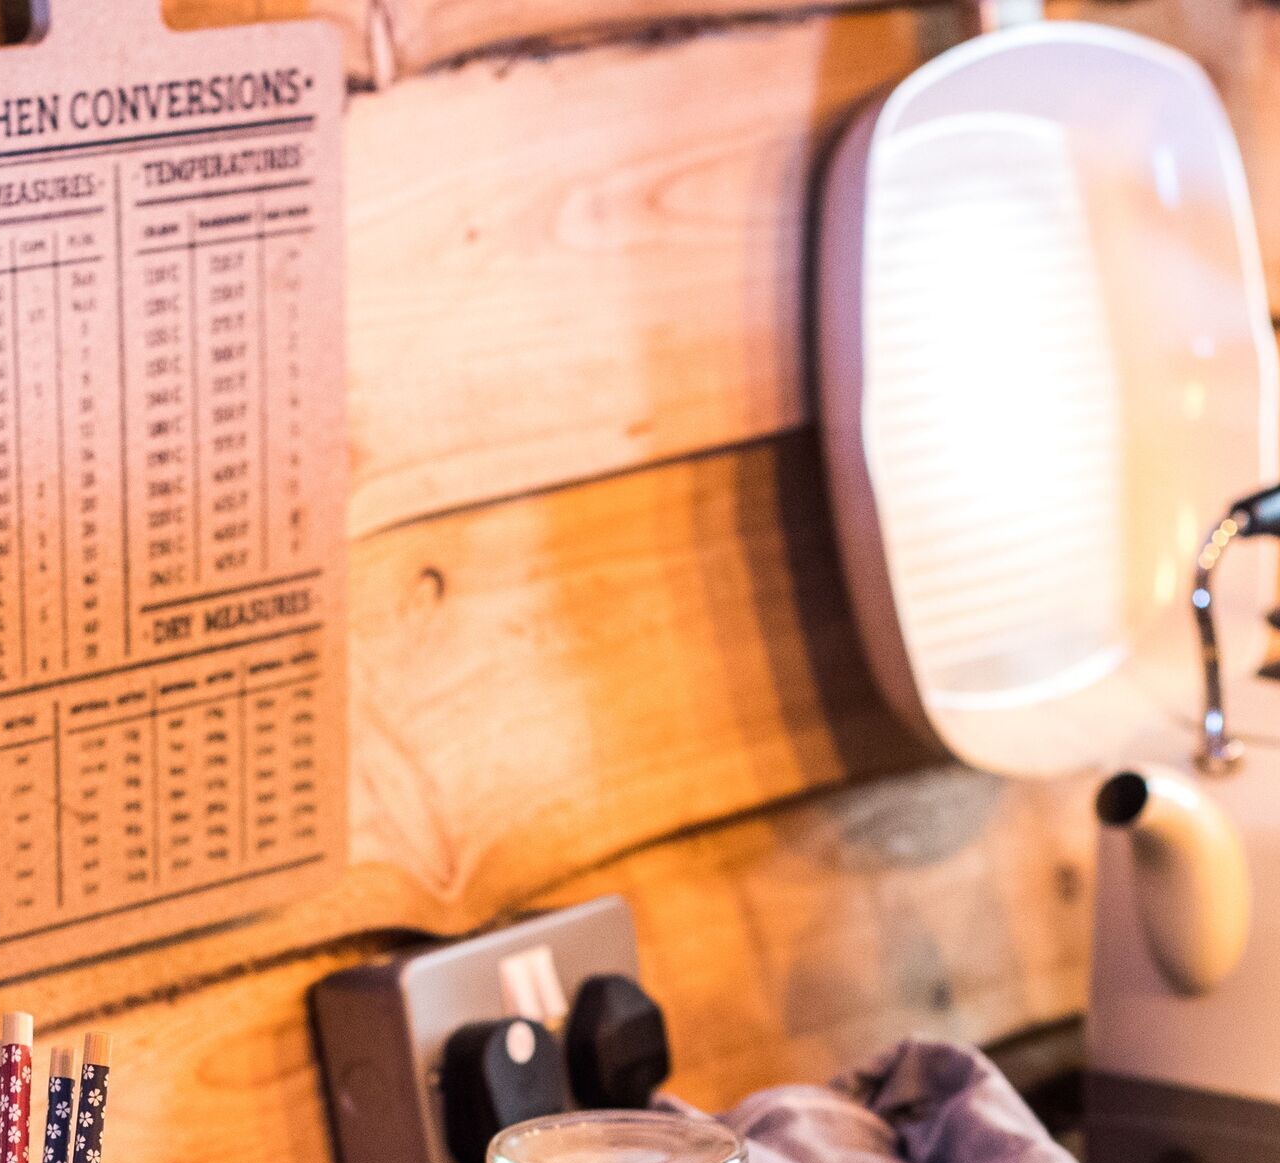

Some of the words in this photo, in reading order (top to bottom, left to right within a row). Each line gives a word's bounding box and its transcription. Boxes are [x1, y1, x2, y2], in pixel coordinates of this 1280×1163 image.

[70, 67, 299, 129] CONVERSIONS
[143, 143, 303, 187] TEMPERATURES
[152, 614, 192, 645] DRY
[204, 586, 312, 633] MEASURES
